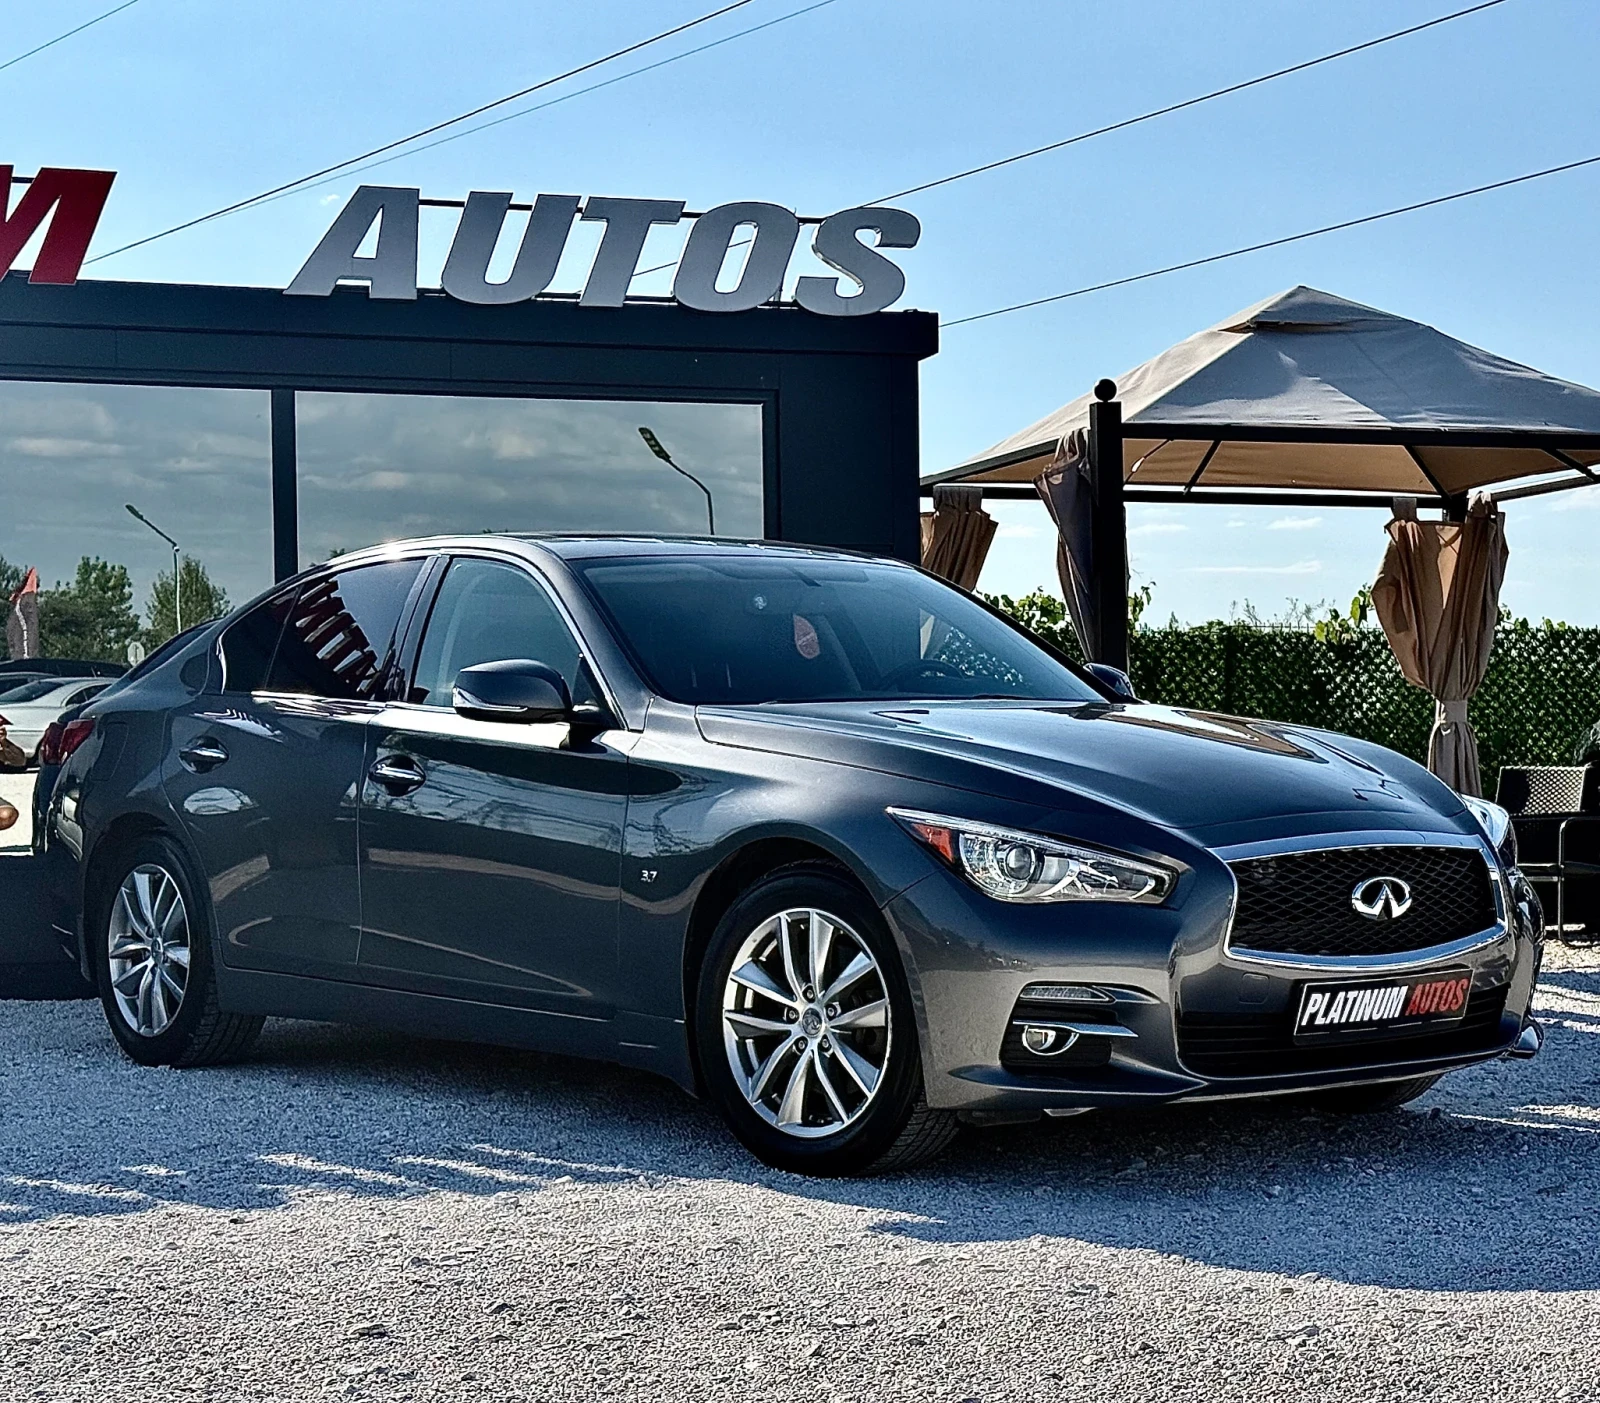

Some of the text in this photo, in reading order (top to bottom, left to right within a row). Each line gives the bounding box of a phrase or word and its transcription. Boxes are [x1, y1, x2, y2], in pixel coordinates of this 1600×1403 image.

[283, 185, 920, 316] AUTOS
[1301, 978, 1469, 1026] PLATINUM AUTOS
